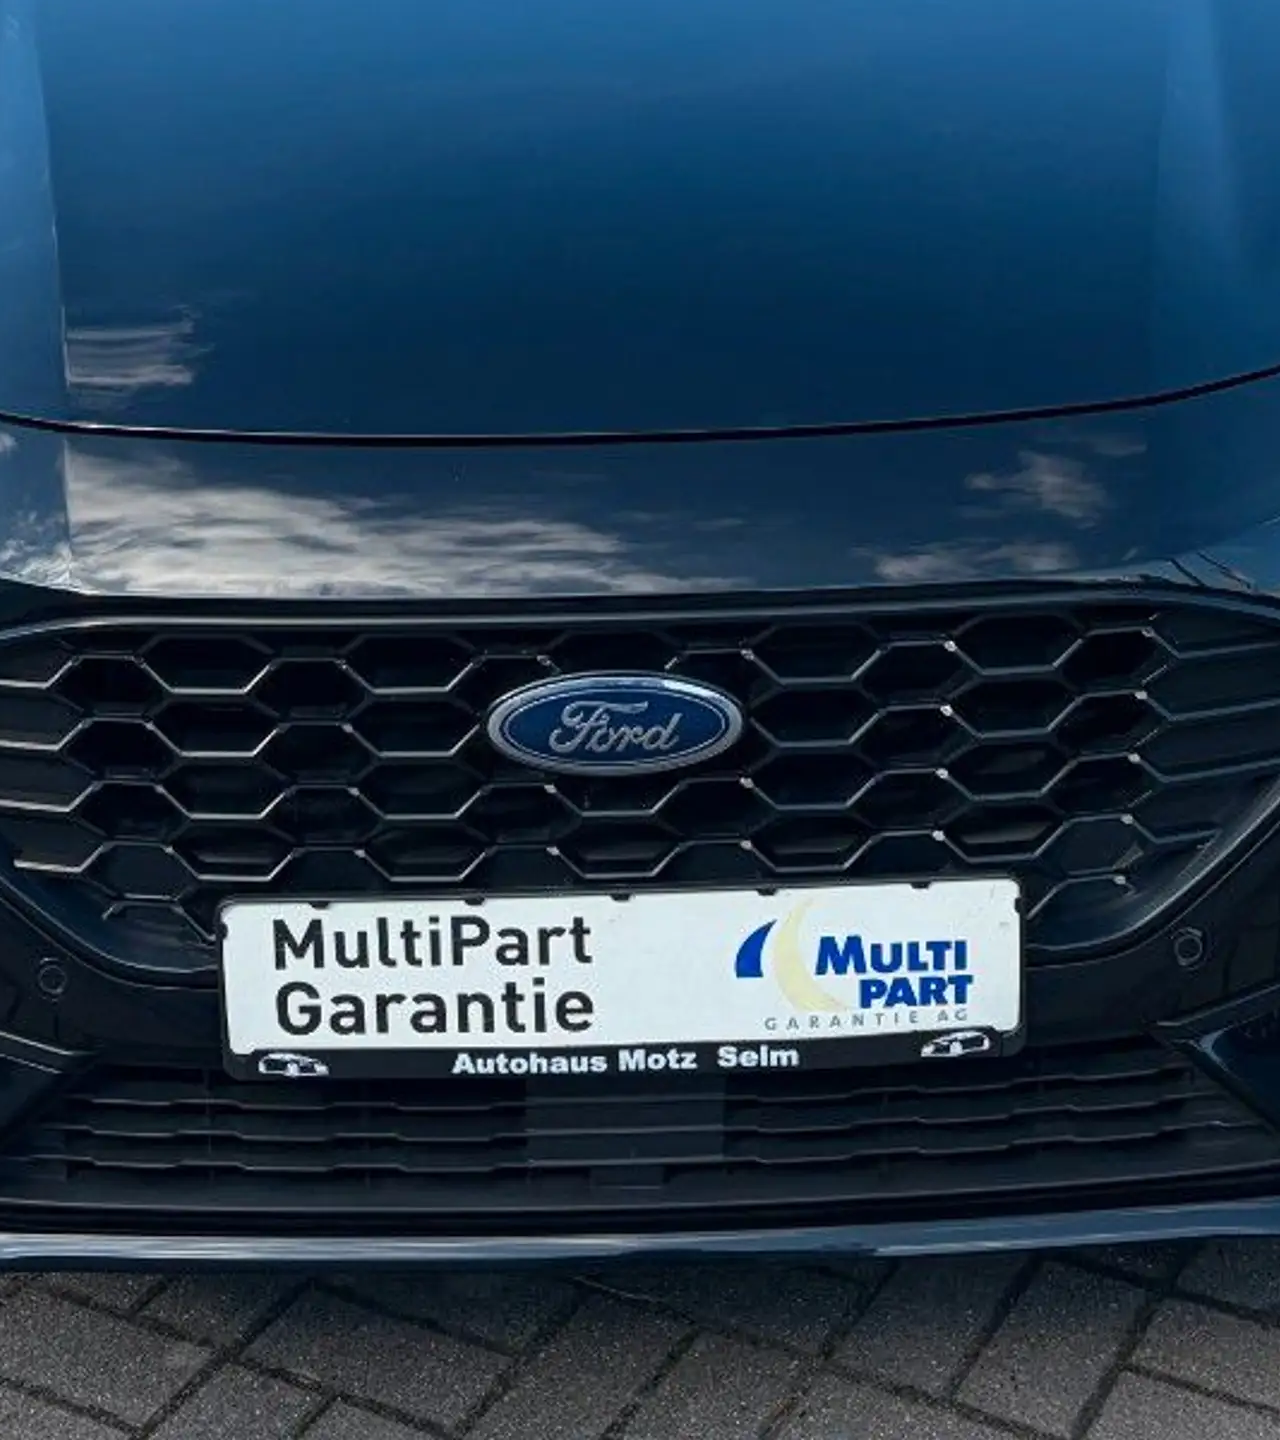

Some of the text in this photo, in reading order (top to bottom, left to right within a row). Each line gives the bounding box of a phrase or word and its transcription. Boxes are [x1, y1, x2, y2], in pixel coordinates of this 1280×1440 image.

[548, 700, 683, 753] Ford
[272, 916, 593, 970] MultiPart
[815, 934, 968, 975] MULTI
[276, 977, 594, 1035] Garantie
[859, 974, 974, 1009] PART
[764, 1008, 969, 1032] GARANTIE AG
[452, 1044, 801, 1075] Autohaus Motz Selm
